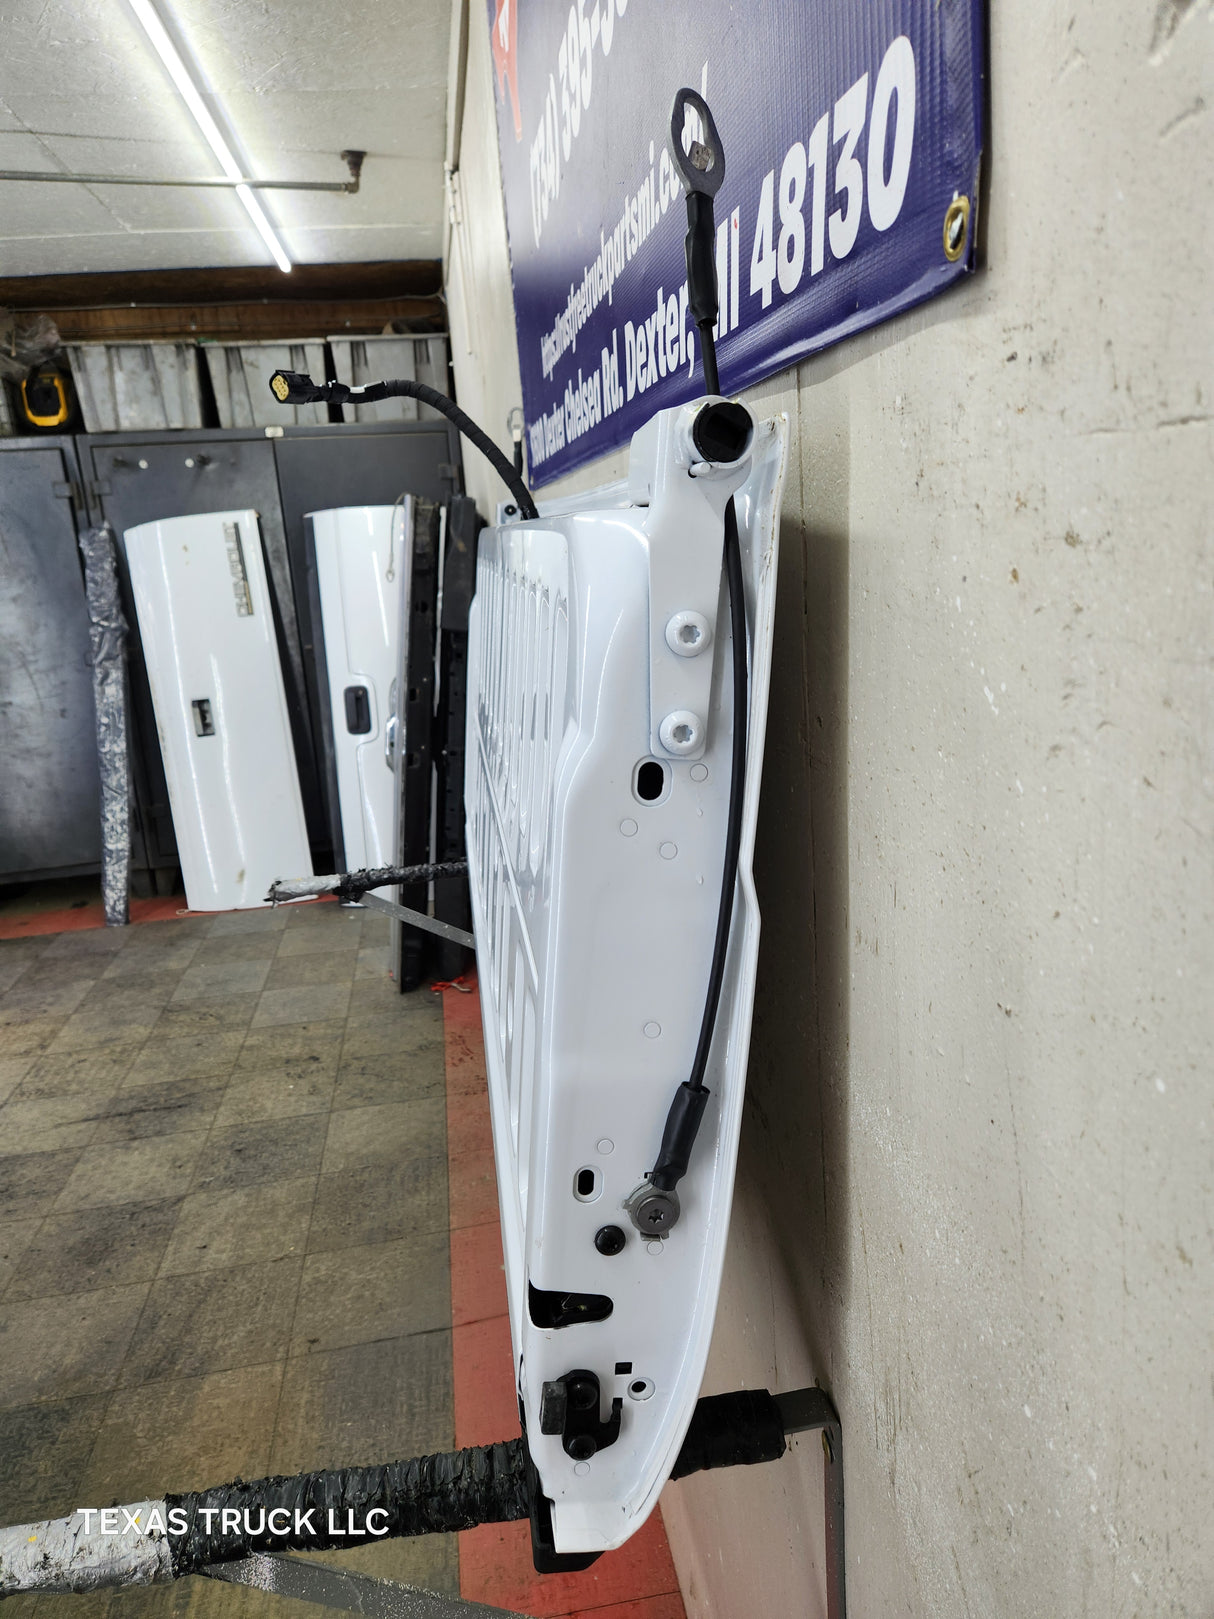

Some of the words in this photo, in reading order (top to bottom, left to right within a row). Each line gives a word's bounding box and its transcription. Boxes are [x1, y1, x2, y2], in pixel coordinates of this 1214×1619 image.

[530, 73, 559, 248] (734)
[558, 0, 628, 162] 395-
[564, 368, 601, 443] Chelsea
[601, 328, 624, 418] Rd.
[624, 280, 695, 402] Dexter,
[750, 35, 916, 310] 48130
